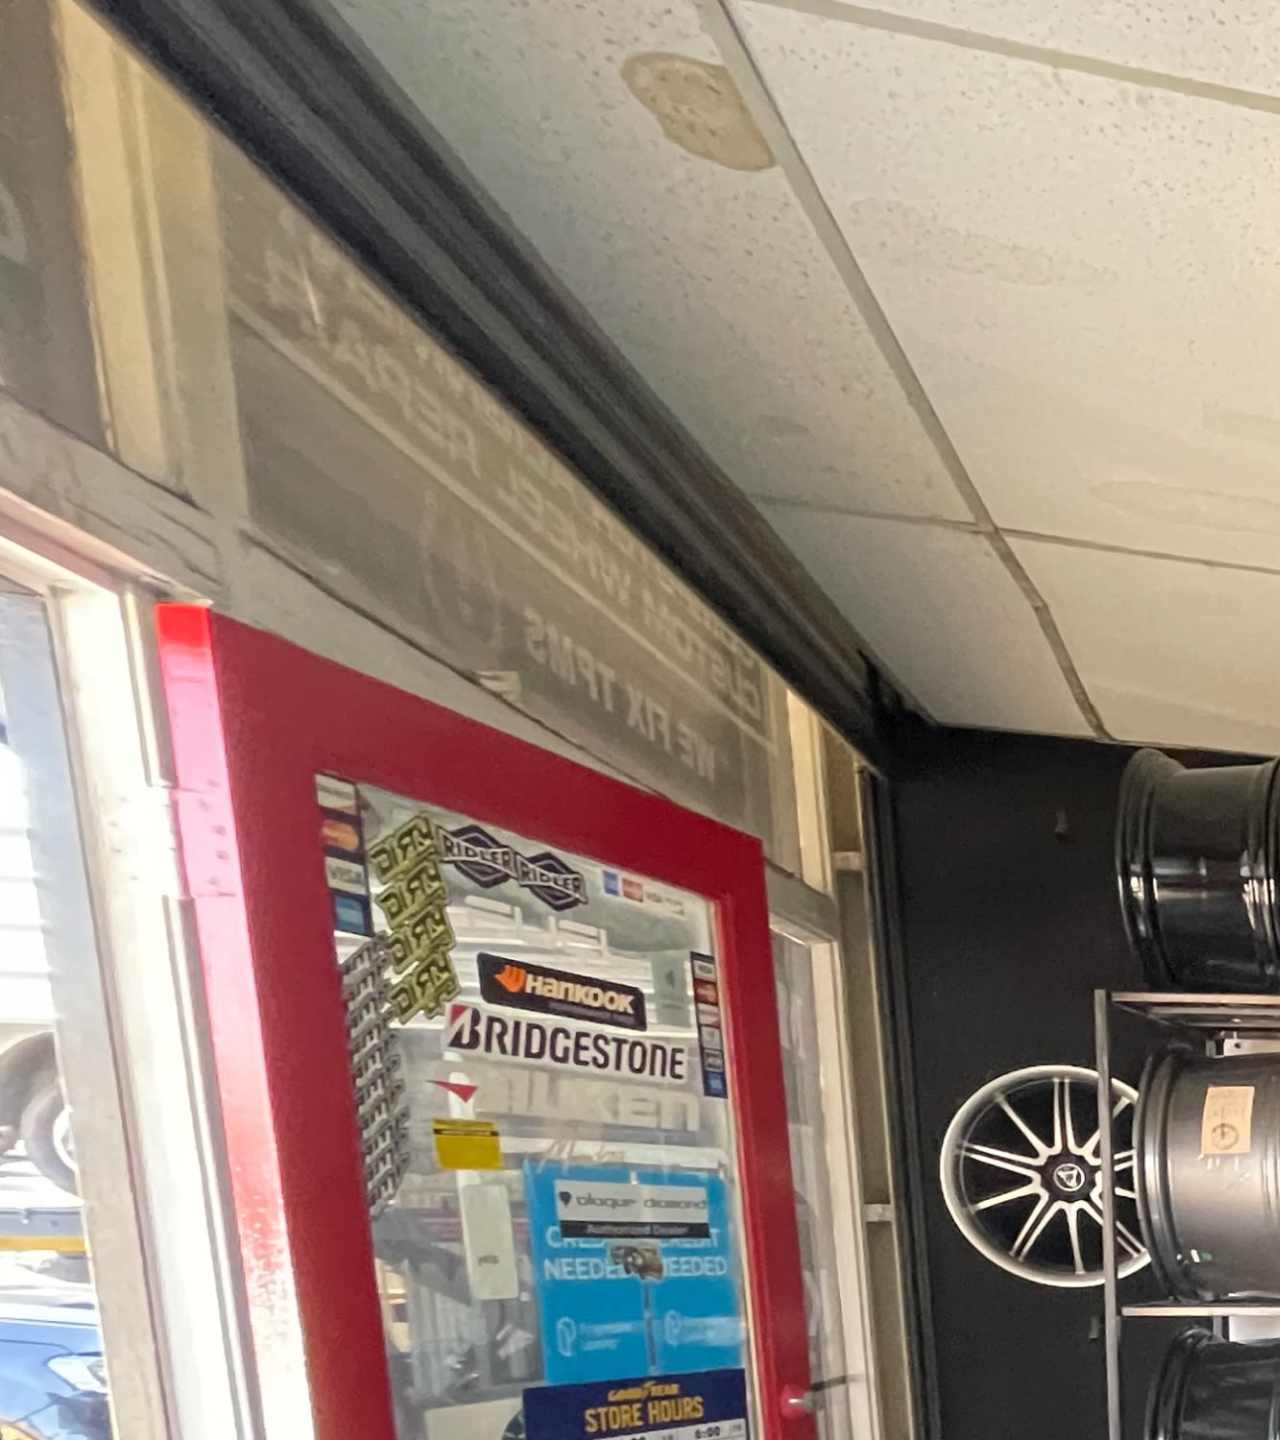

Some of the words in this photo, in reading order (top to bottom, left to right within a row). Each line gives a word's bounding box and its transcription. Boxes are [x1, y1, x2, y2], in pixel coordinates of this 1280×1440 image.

[443, 834, 511, 867] RIDLER
[520, 860, 581, 892] RIDLER
[447, 1004, 686, 1080] BRIDGESTONE
[662, 1256, 728, 1278] EEDED
[584, 1401, 644, 1432] STORE
[648, 1396, 704, 1424] HOURS
